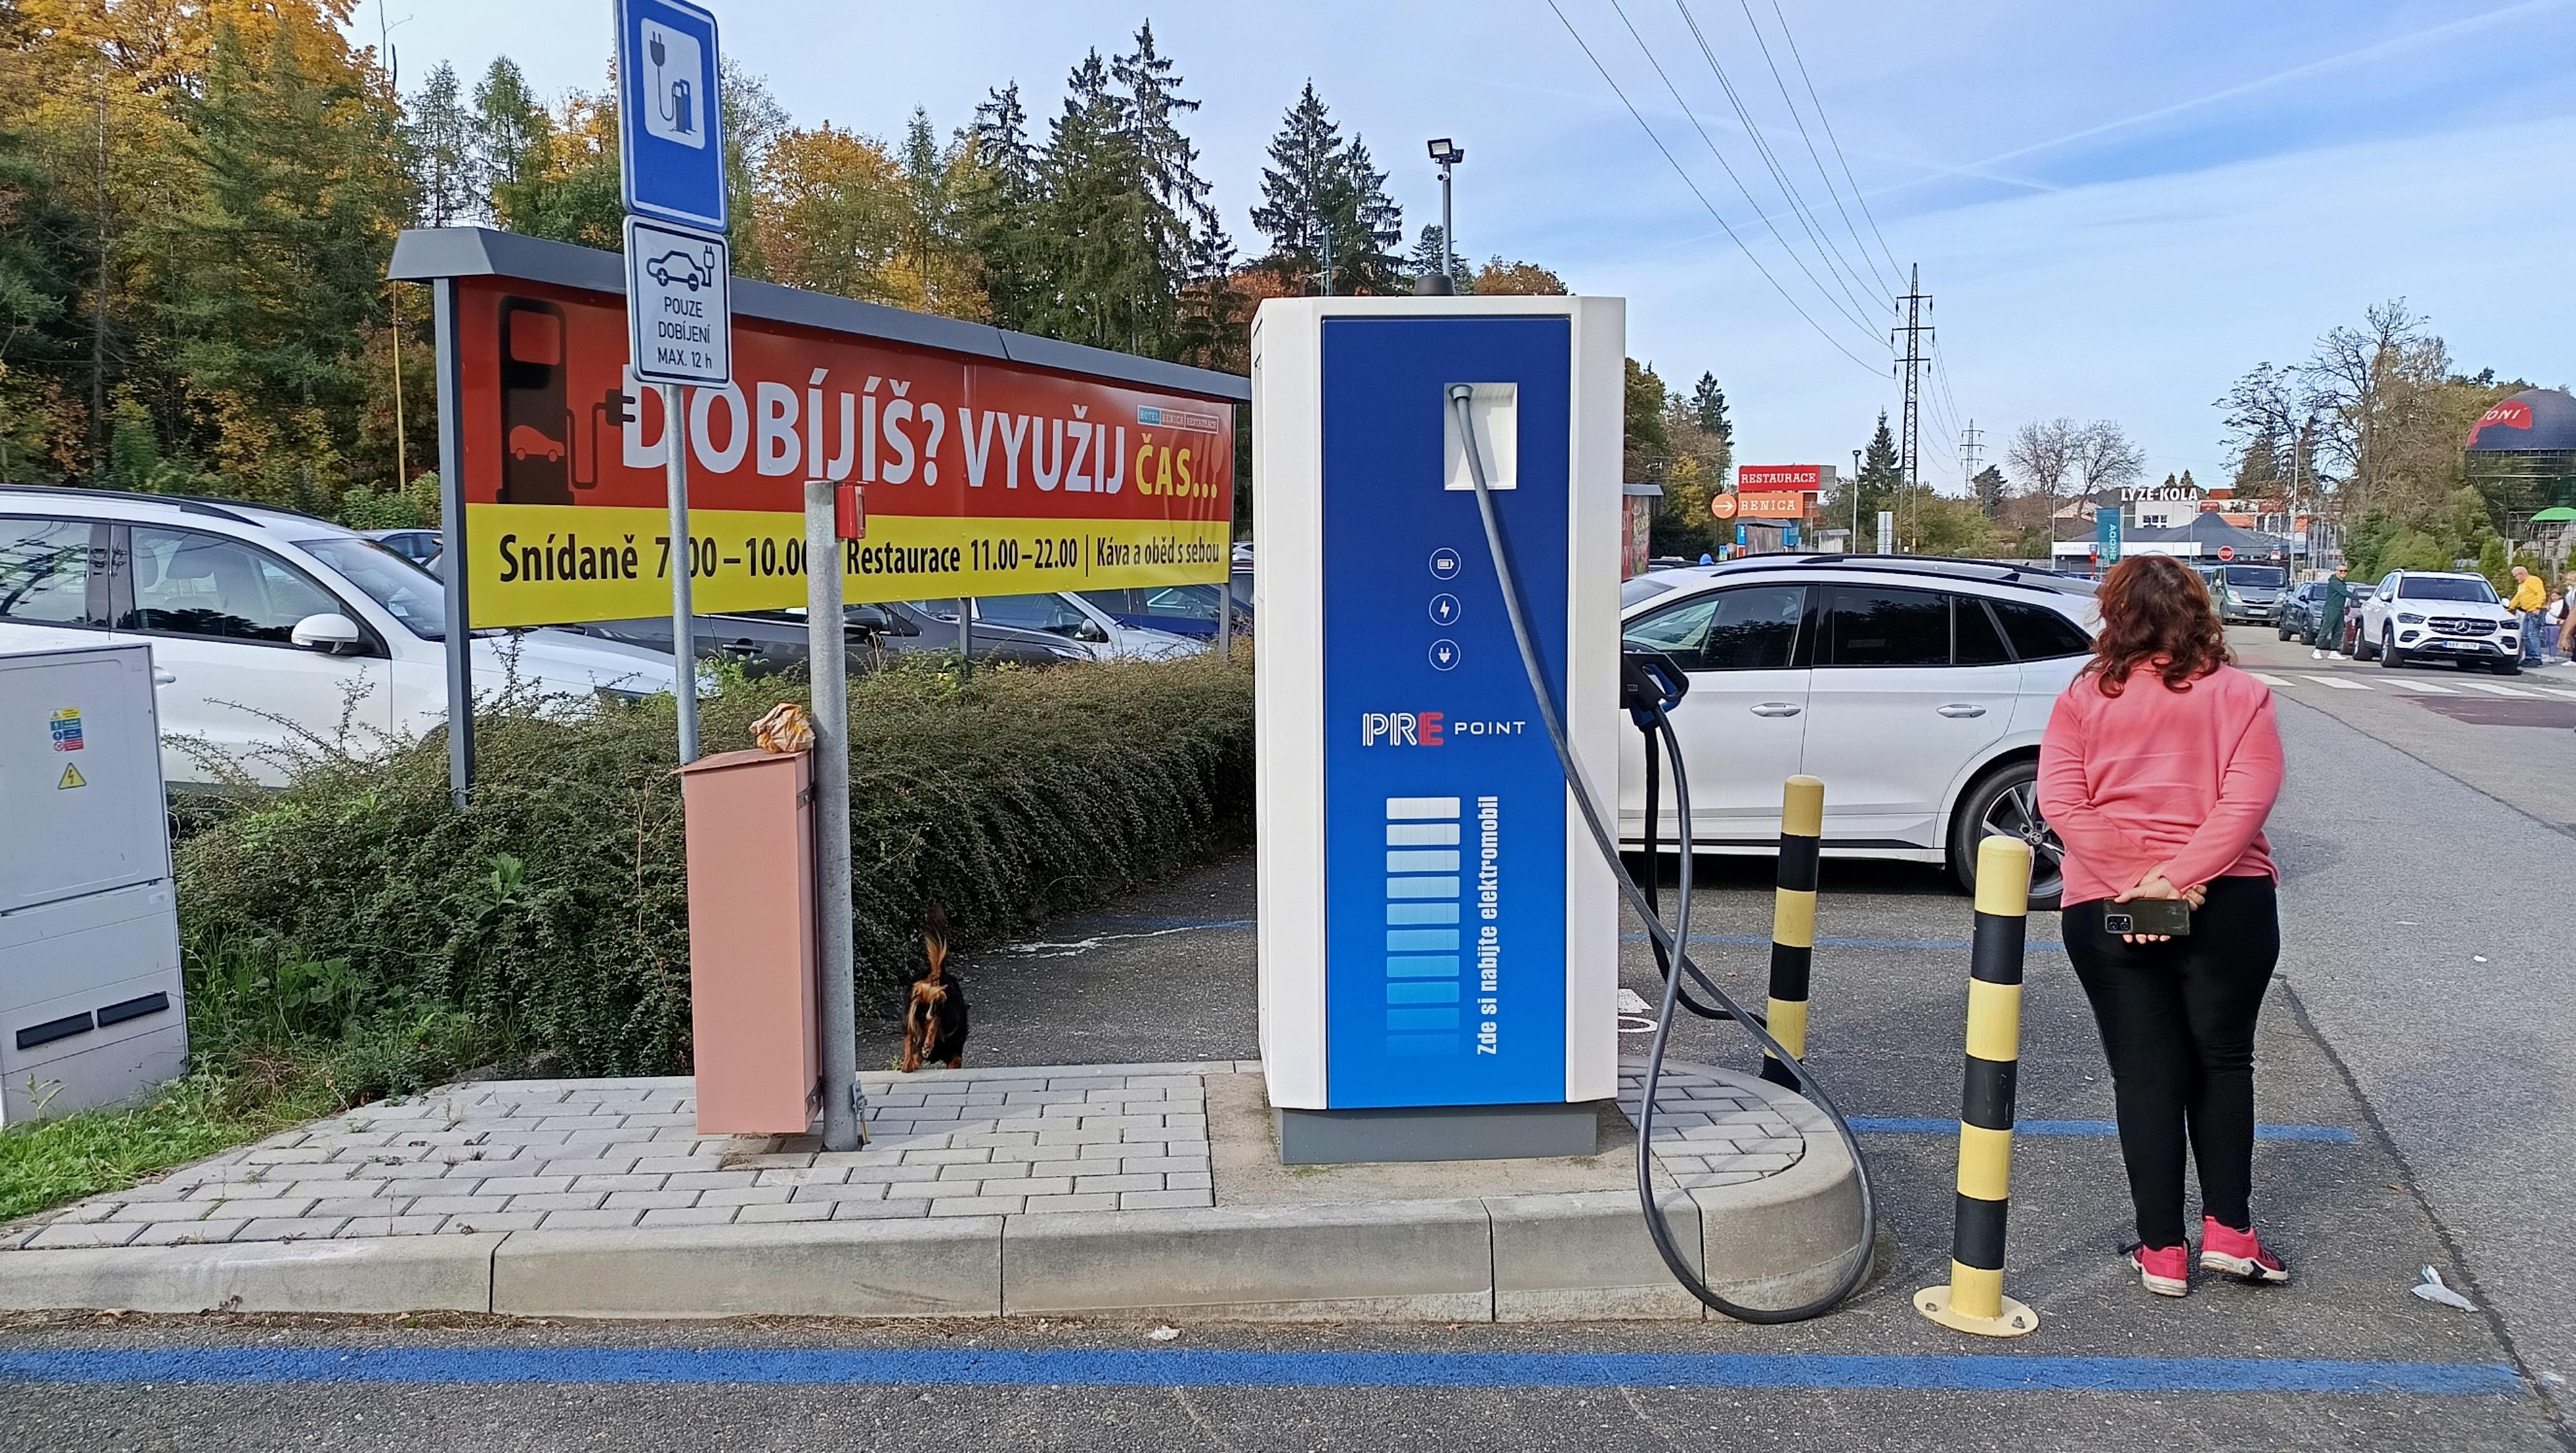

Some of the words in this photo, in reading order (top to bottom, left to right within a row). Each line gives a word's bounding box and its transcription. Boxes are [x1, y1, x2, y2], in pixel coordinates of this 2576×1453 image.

[664, 296, 703, 318] POUZE
[658, 320, 710, 343] DOBÍJENÍ
[658, 347, 687, 366] MAX.
[692, 351, 701, 368] 12
[705, 353, 712, 369] h
[1140, 410, 1159, 422] HOTEL
[1162, 413, 1184, 425] BENICA
[623, 364, 945, 486] DOBÍJÍŠ?
[958, 404, 1124, 495] VYUŽIJ
[1135, 433, 1218, 499] ČAS...
[1741, 473, 1816, 484] RESTAURACE
[1741, 500, 1795, 511] BENICA
[500, 533, 638, 582] Snídaně
[847, 538, 960, 575] Restaurace
[1097, 537, 1129, 566] Káva
[1133, 544, 1141, 564] a
[1145, 536, 1175, 564] oběd
[1178, 544, 1183, 564] s
[1186, 536, 1220, 563] sebou
[1362, 712, 1444, 746] PRE
[1454, 721, 1526, 735] POINT
[1477, 796, 1498, 919] elektromobil
[1477, 926, 1500, 991] nabijte
[1477, 998, 1497, 1014] si
[1477, 1021, 1497, 1055] Zde
